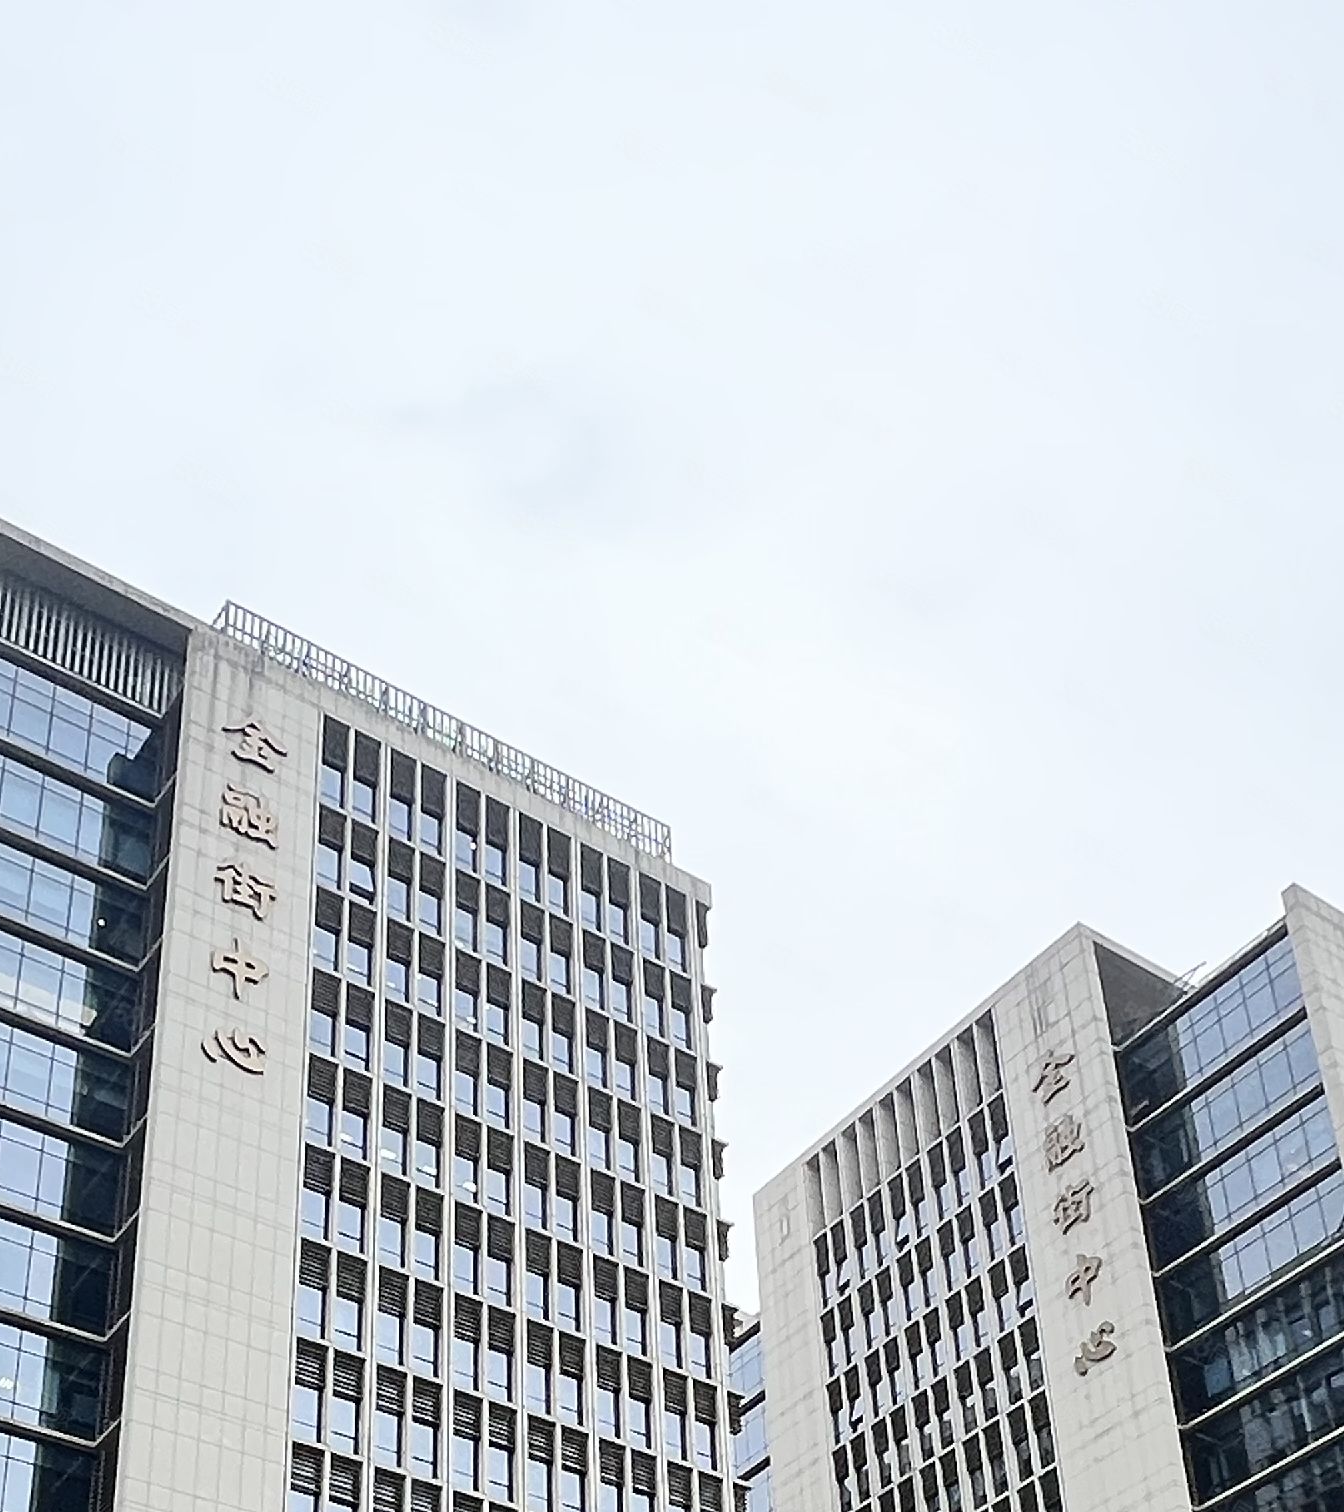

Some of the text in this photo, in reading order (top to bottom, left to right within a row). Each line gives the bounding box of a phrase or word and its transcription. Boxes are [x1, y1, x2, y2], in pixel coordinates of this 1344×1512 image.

[200, 717, 288, 1076] 金融街中心
[1031, 1048, 1118, 1378] 金融街中心
